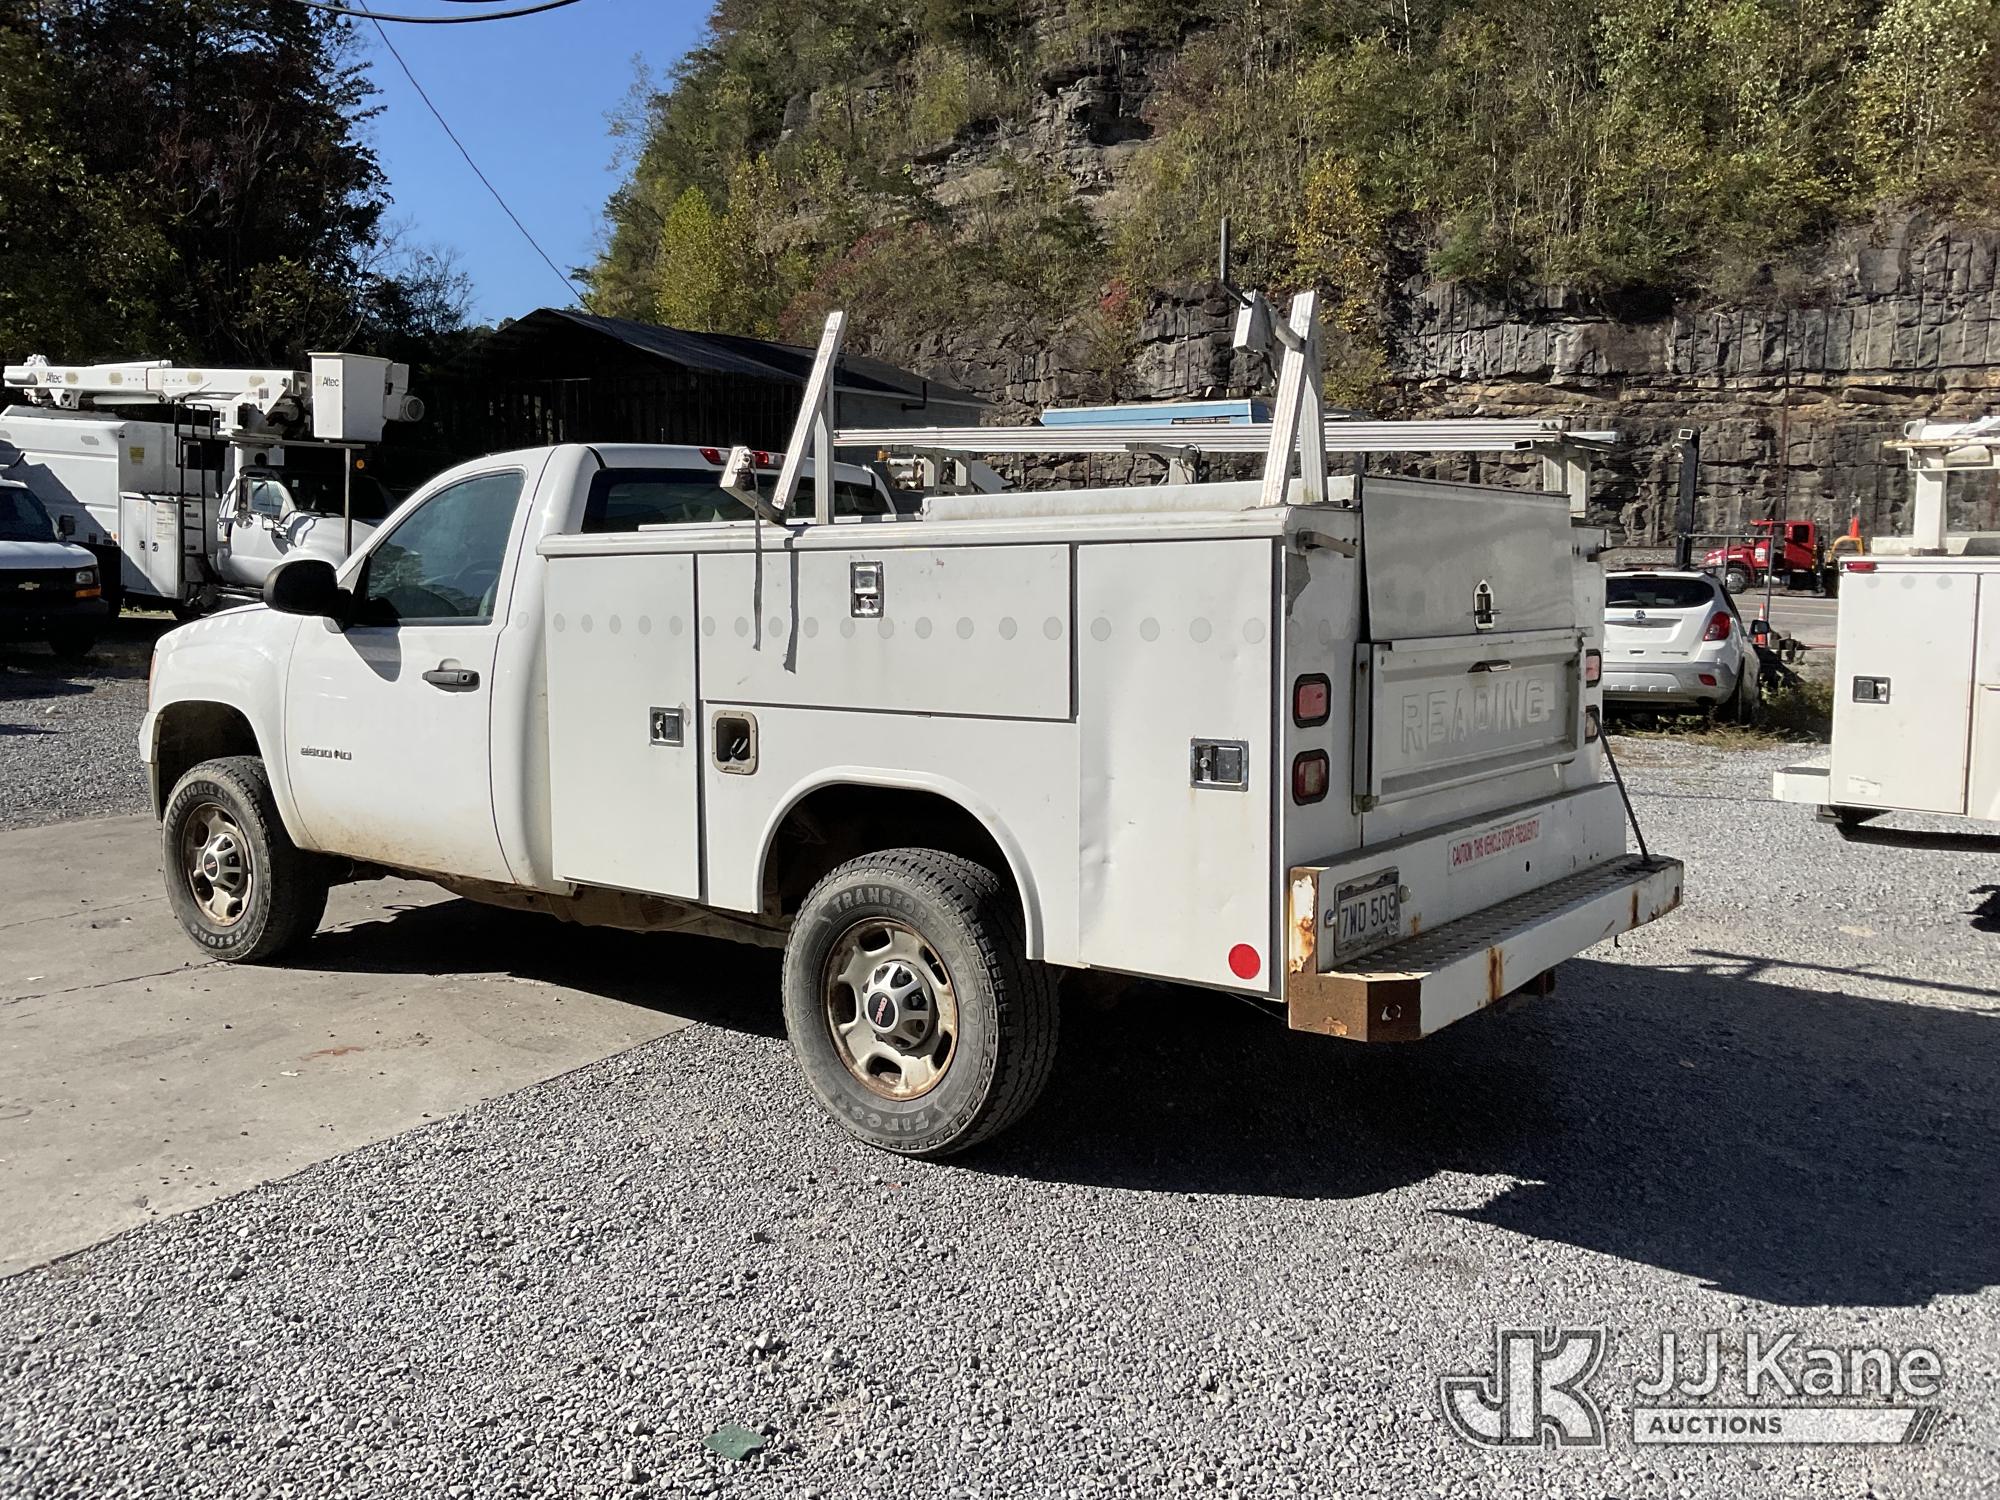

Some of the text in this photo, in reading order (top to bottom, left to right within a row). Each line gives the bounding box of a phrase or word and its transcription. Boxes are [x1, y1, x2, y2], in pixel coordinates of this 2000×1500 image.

[45, 372, 63, 383] Altec
[323, 377, 340, 387] Altec
[1402, 678, 1553, 753] READING
[1341, 892, 1397, 939] 7WD 509
